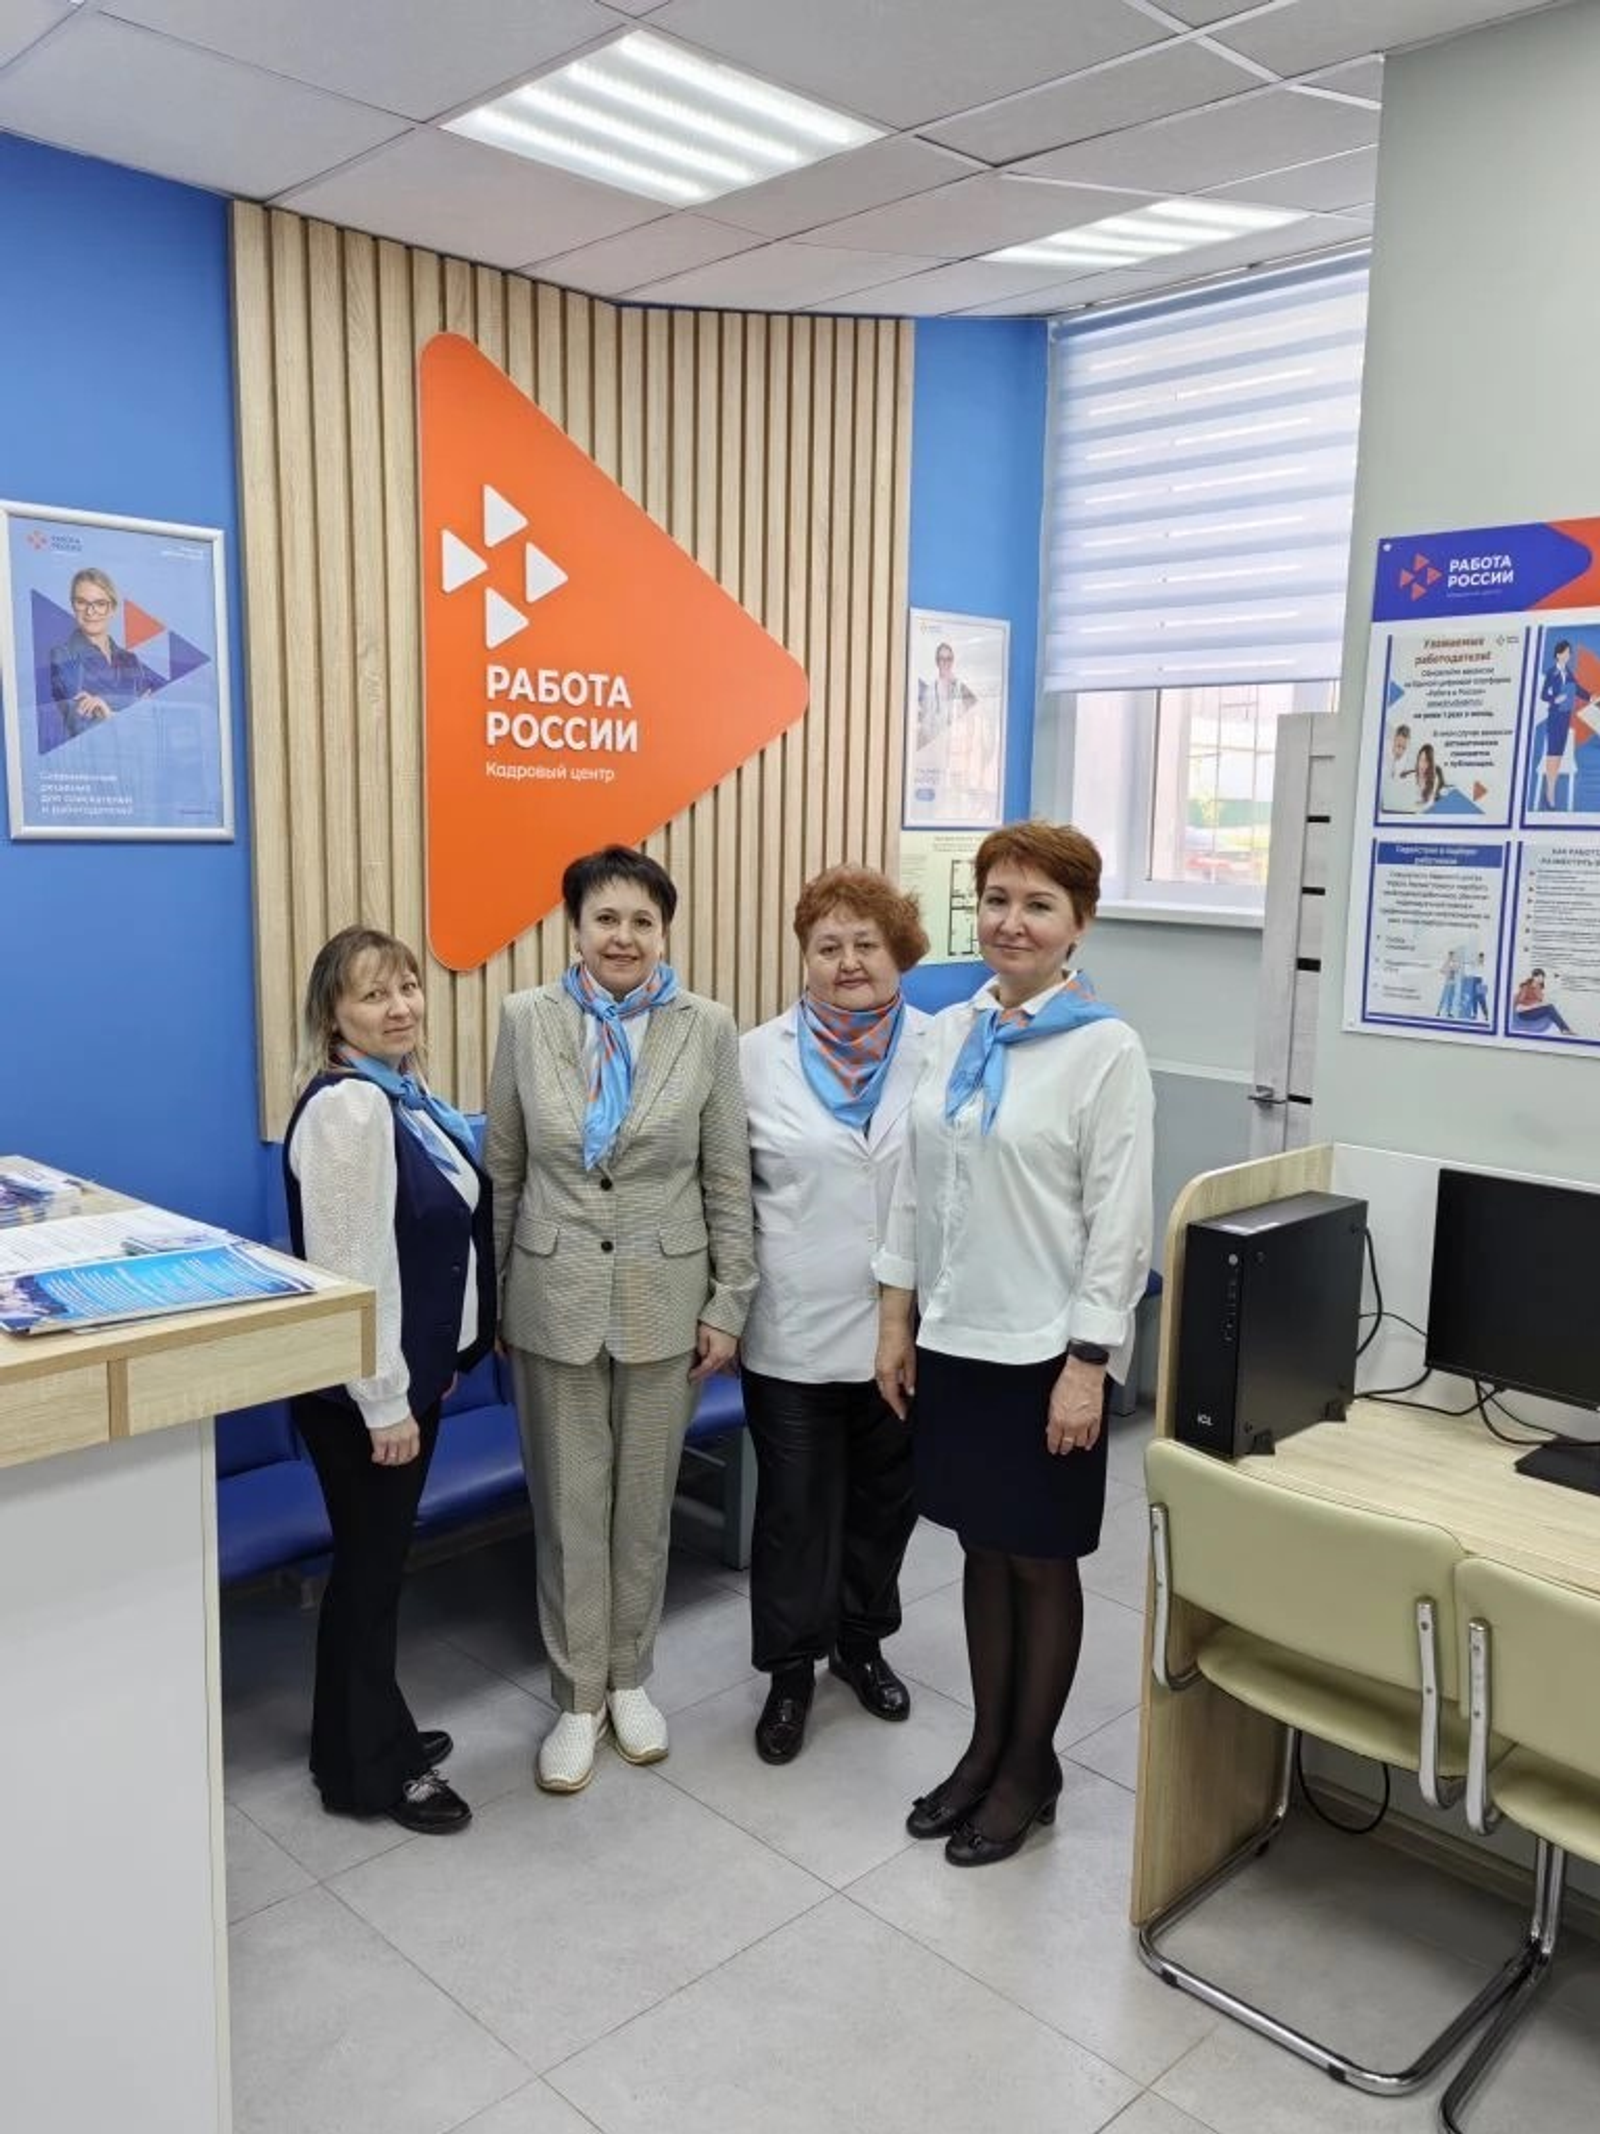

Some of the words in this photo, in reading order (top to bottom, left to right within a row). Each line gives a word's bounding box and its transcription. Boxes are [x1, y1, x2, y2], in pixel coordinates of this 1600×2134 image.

[1449, 554, 1513, 573] РАБОТА
[1447, 570, 1515, 588] РОССИИ
[486, 664, 632, 709] РАБОТА
[486, 711, 638, 752] РОССИИ
[485, 761, 568, 782] Кадровый
[571, 767, 615, 783] центр
